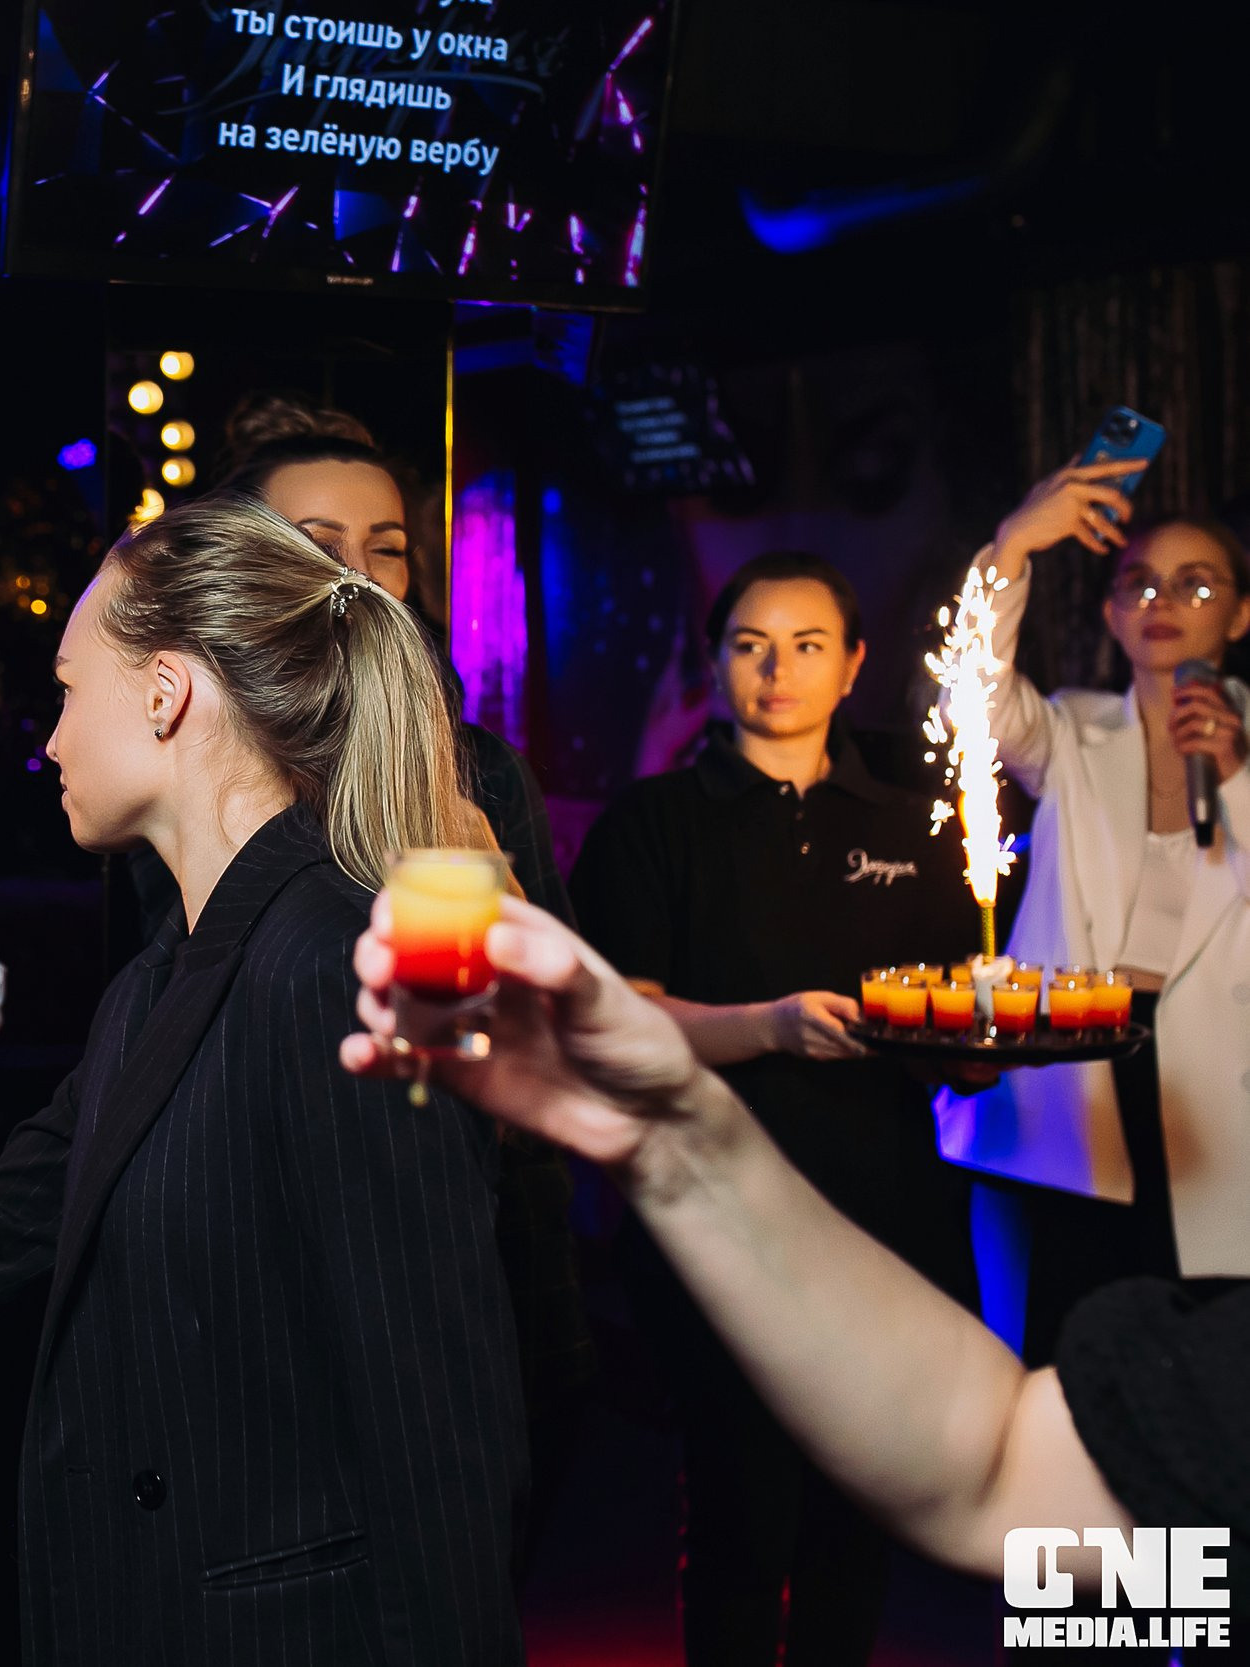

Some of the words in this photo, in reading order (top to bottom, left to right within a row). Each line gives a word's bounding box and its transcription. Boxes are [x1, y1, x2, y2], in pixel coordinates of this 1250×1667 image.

[231, 8, 276, 36] ты
[284, 14, 404, 50] стоишь
[410, 28, 432, 60] у
[437, 32, 508, 62] окна
[281, 63, 306, 96] И
[313, 73, 452, 110] глядишь
[218, 122, 256, 149] на
[264, 123, 402, 166] зелёную
[409, 137, 500, 176] вербу
